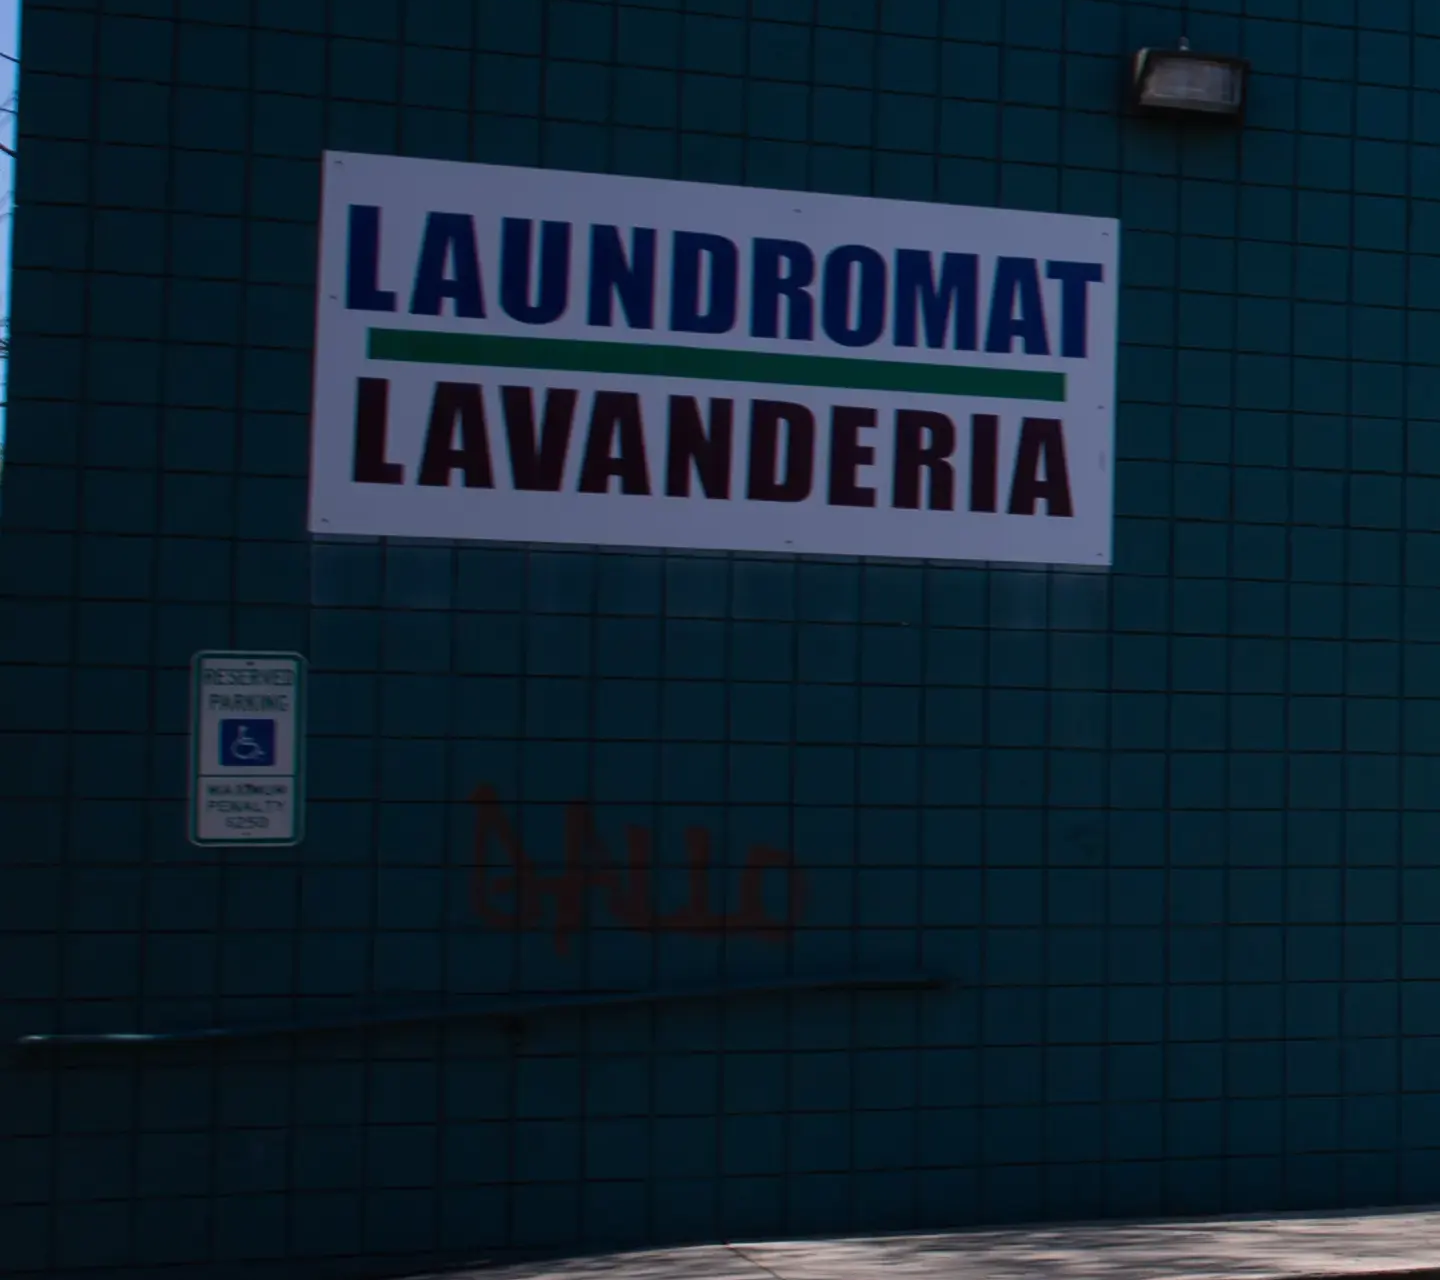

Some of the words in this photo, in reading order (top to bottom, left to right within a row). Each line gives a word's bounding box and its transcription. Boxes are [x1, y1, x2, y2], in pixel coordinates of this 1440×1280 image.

[344, 203, 1104, 358] LAUNDROMAT
[351, 376, 1074, 517] LAVANDERIA
[208, 694, 289, 711] PARKING
[206, 800, 286, 812] PENALTY
